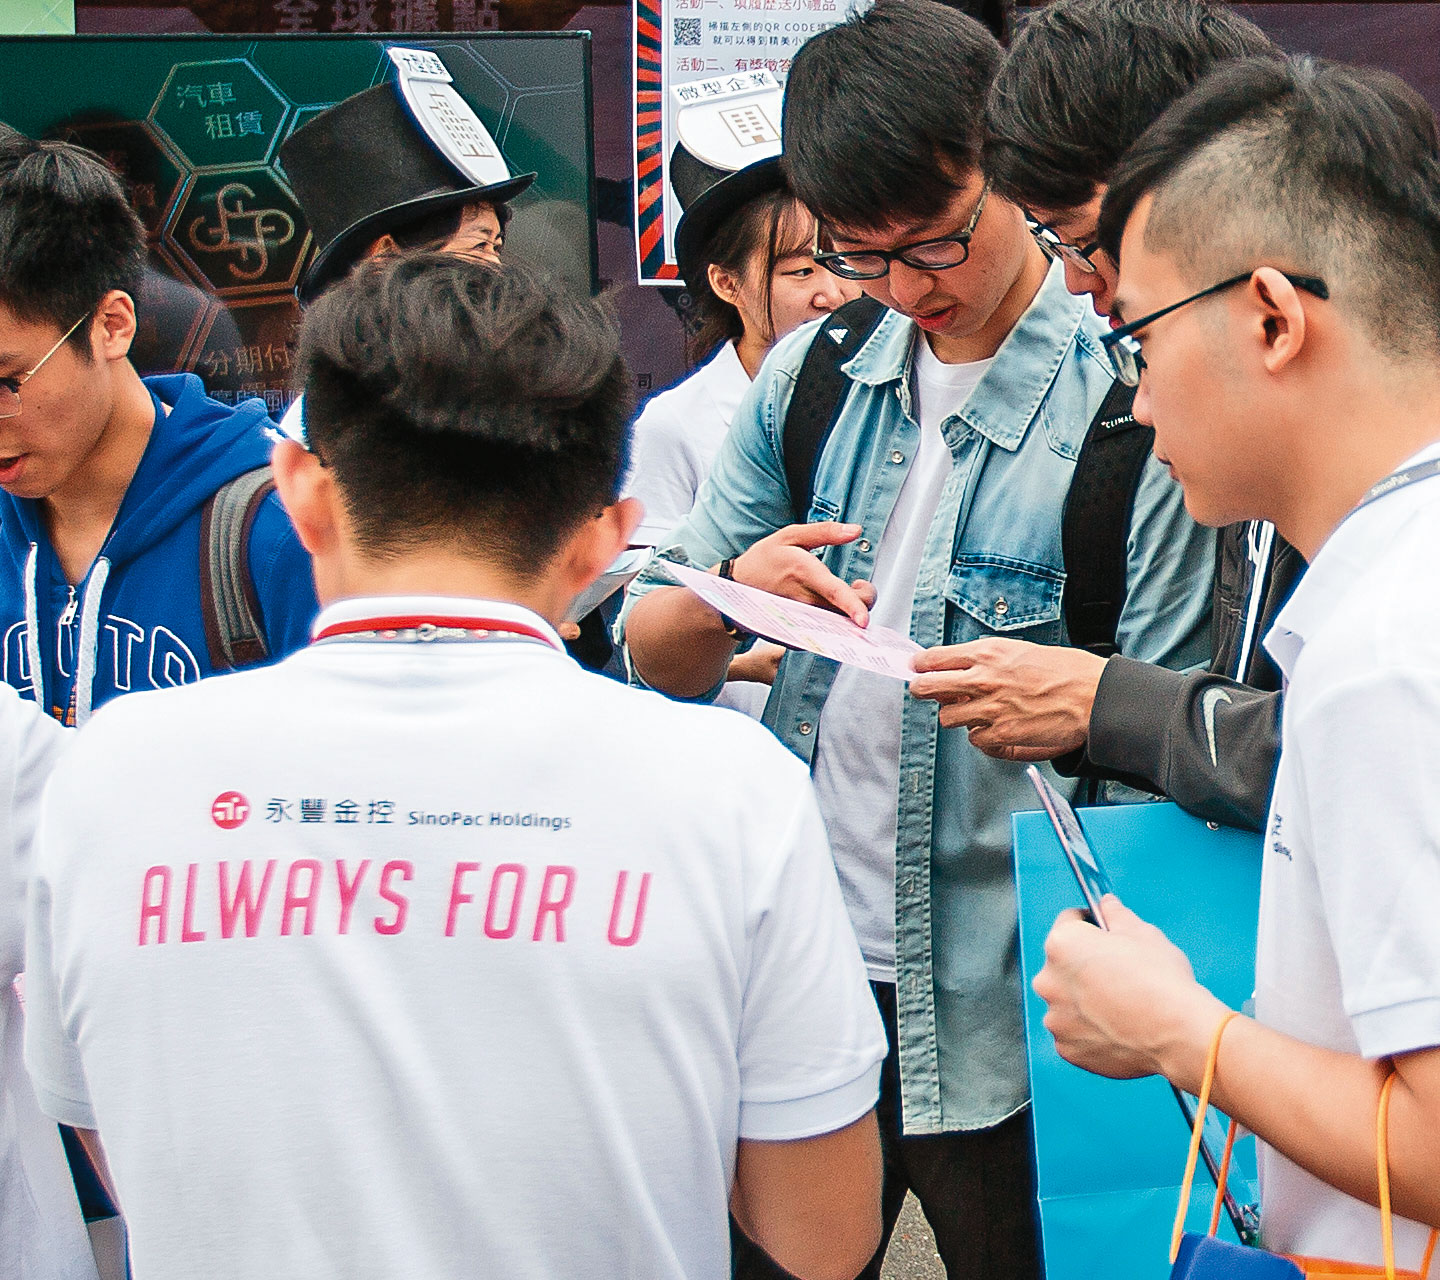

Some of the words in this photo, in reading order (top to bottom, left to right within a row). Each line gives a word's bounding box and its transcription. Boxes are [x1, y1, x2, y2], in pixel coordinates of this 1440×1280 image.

[713, 35, 809, 46] 就可以得到精美小
[177, 82, 237, 107] 汽車
[206, 111, 264, 139] 租賃
[1105, 414, 1136, 429] CLIMAC
[265, 797, 395, 826] 永豐金控
[409, 808, 483, 828] SinoPac
[490, 811, 572, 832] Holdings
[138, 859, 414, 947] ALWAYS
[443, 860, 578, 943] FOR
[605, 870, 653, 947] U
